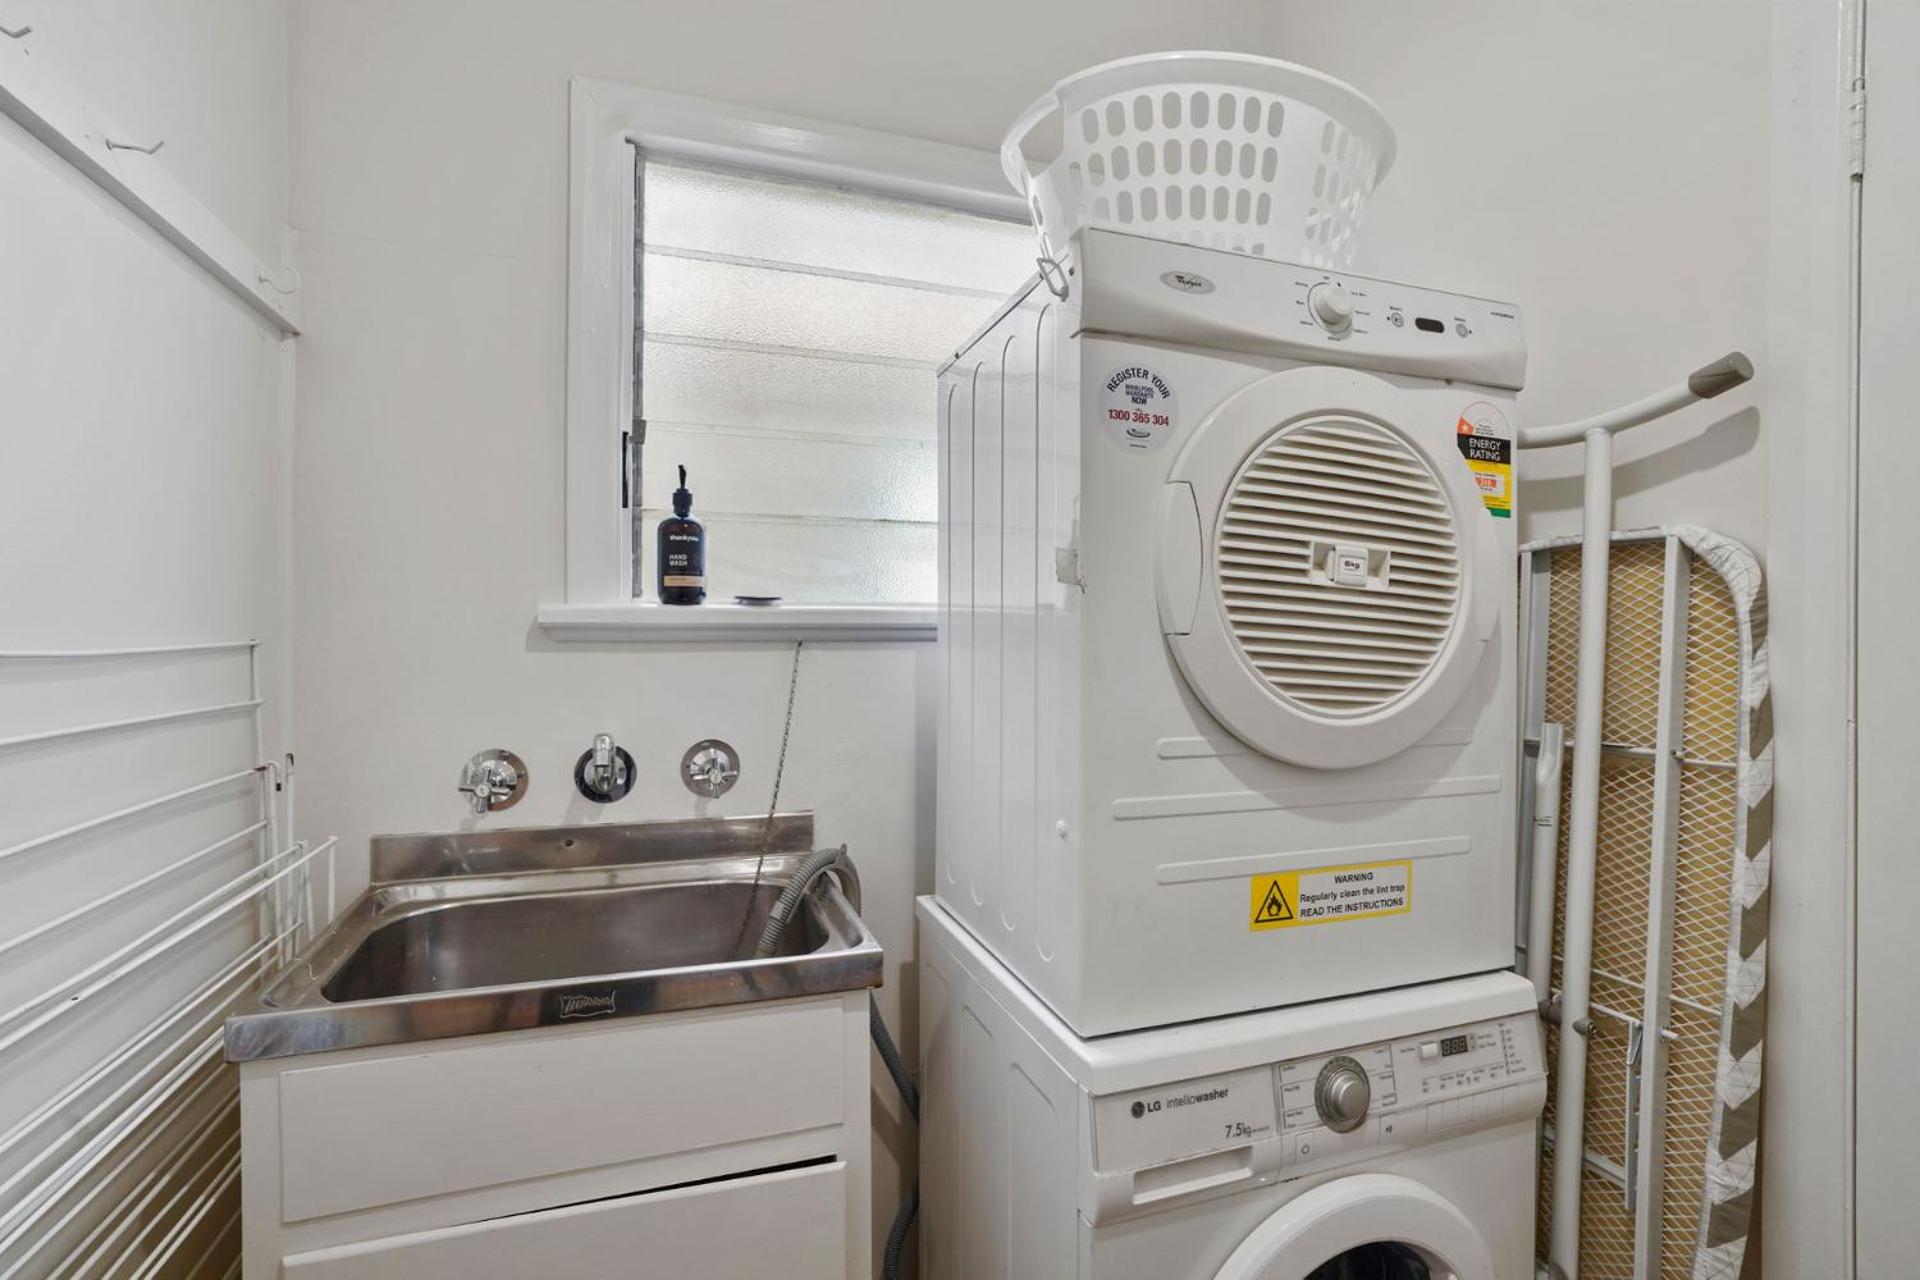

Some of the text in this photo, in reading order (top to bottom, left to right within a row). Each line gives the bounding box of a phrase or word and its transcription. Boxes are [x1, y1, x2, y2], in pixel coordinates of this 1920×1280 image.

[1107, 368, 1171, 399] REGISTER YOUR
[1131, 396, 1147, 405] NOW
[1108, 409, 1169, 426] 1300 365 304
[1469, 438, 1501, 450] ENERGY
[1469, 449, 1501, 461] RATING
[1334, 872, 1373, 884] WARNING
[1300, 884, 1405, 903] Regularly clean the lint trap
[1300, 898, 1404, 917] READ THE INSTRUCTIONS
[1147, 1101, 1162, 1113] LG
